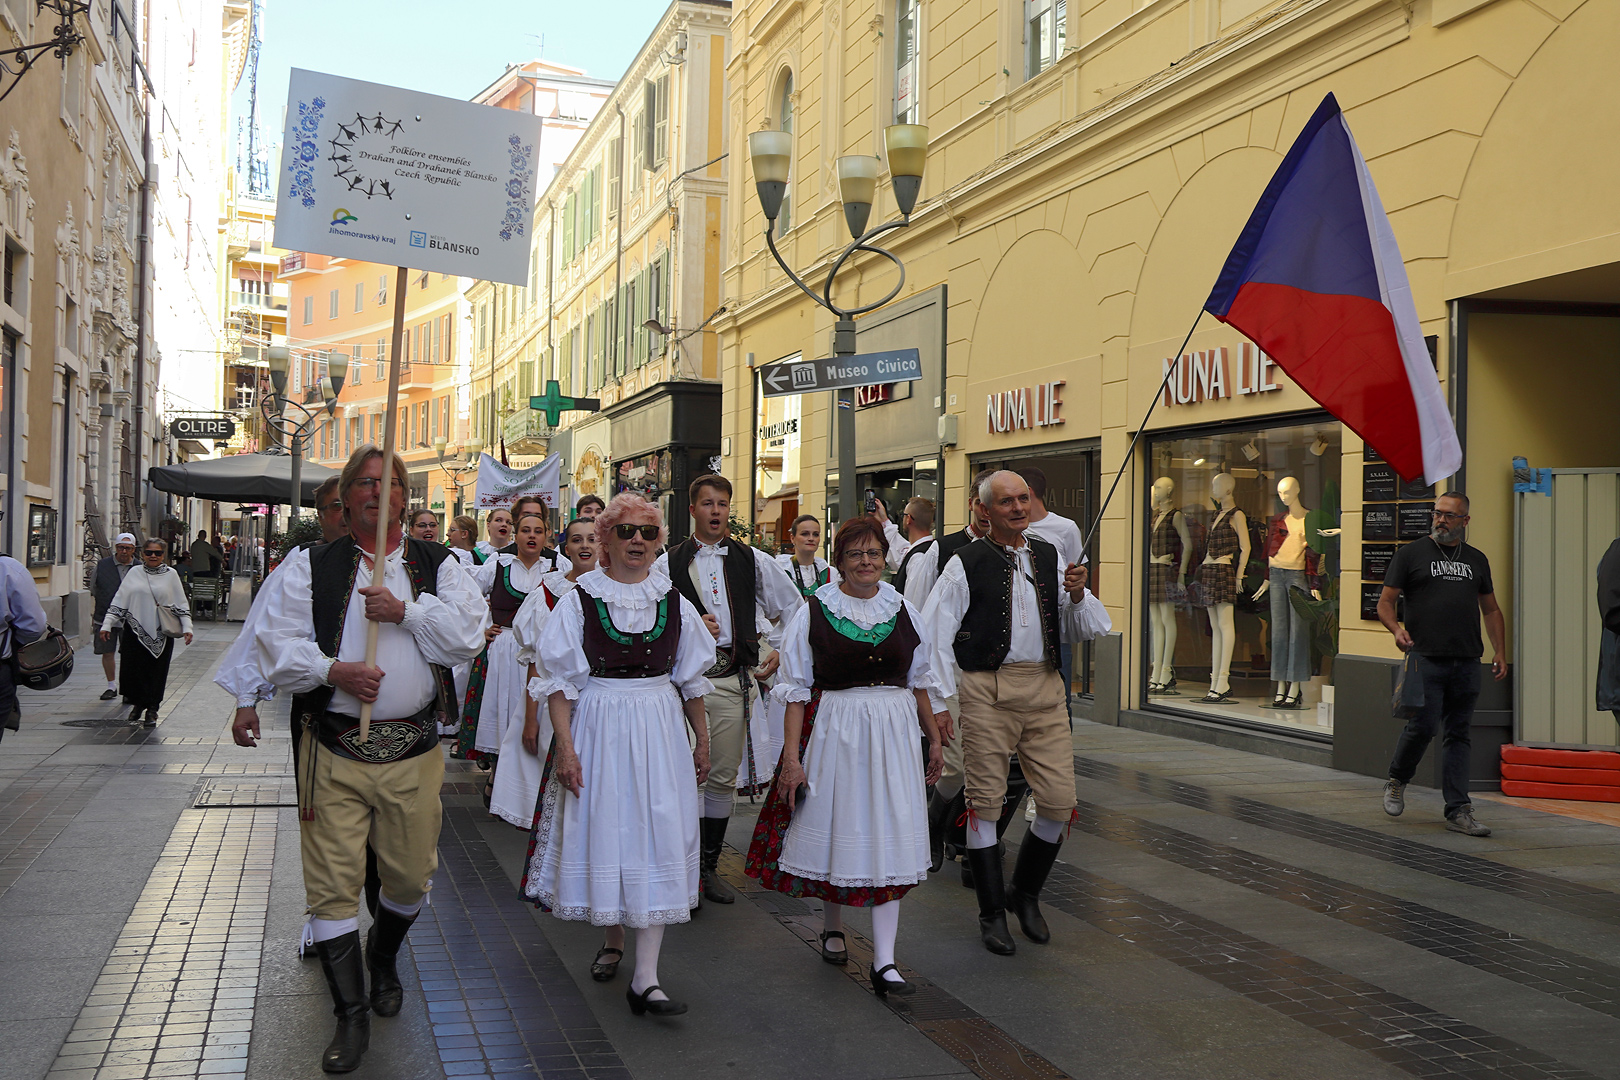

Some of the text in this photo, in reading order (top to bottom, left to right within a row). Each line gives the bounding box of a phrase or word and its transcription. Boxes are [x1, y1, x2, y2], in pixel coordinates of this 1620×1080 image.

[358, 150, 498, 183] Drahan and Drahanek Blansko
[389, 145, 472, 167] Folklore ensembles
[394, 168, 462, 188] Czech Republic
[328, 227, 396, 245] Jihomoravský kraj
[429, 239, 480, 256] BLANSKO
[826, 357, 917, 380] Museo Civico
[1162, 342, 1283, 407] NUNA LIE
[987, 380, 1066, 435] NUNA LIE
[178, 420, 228, 433] OLTRE
[1063, 488, 1085, 508] LIE
